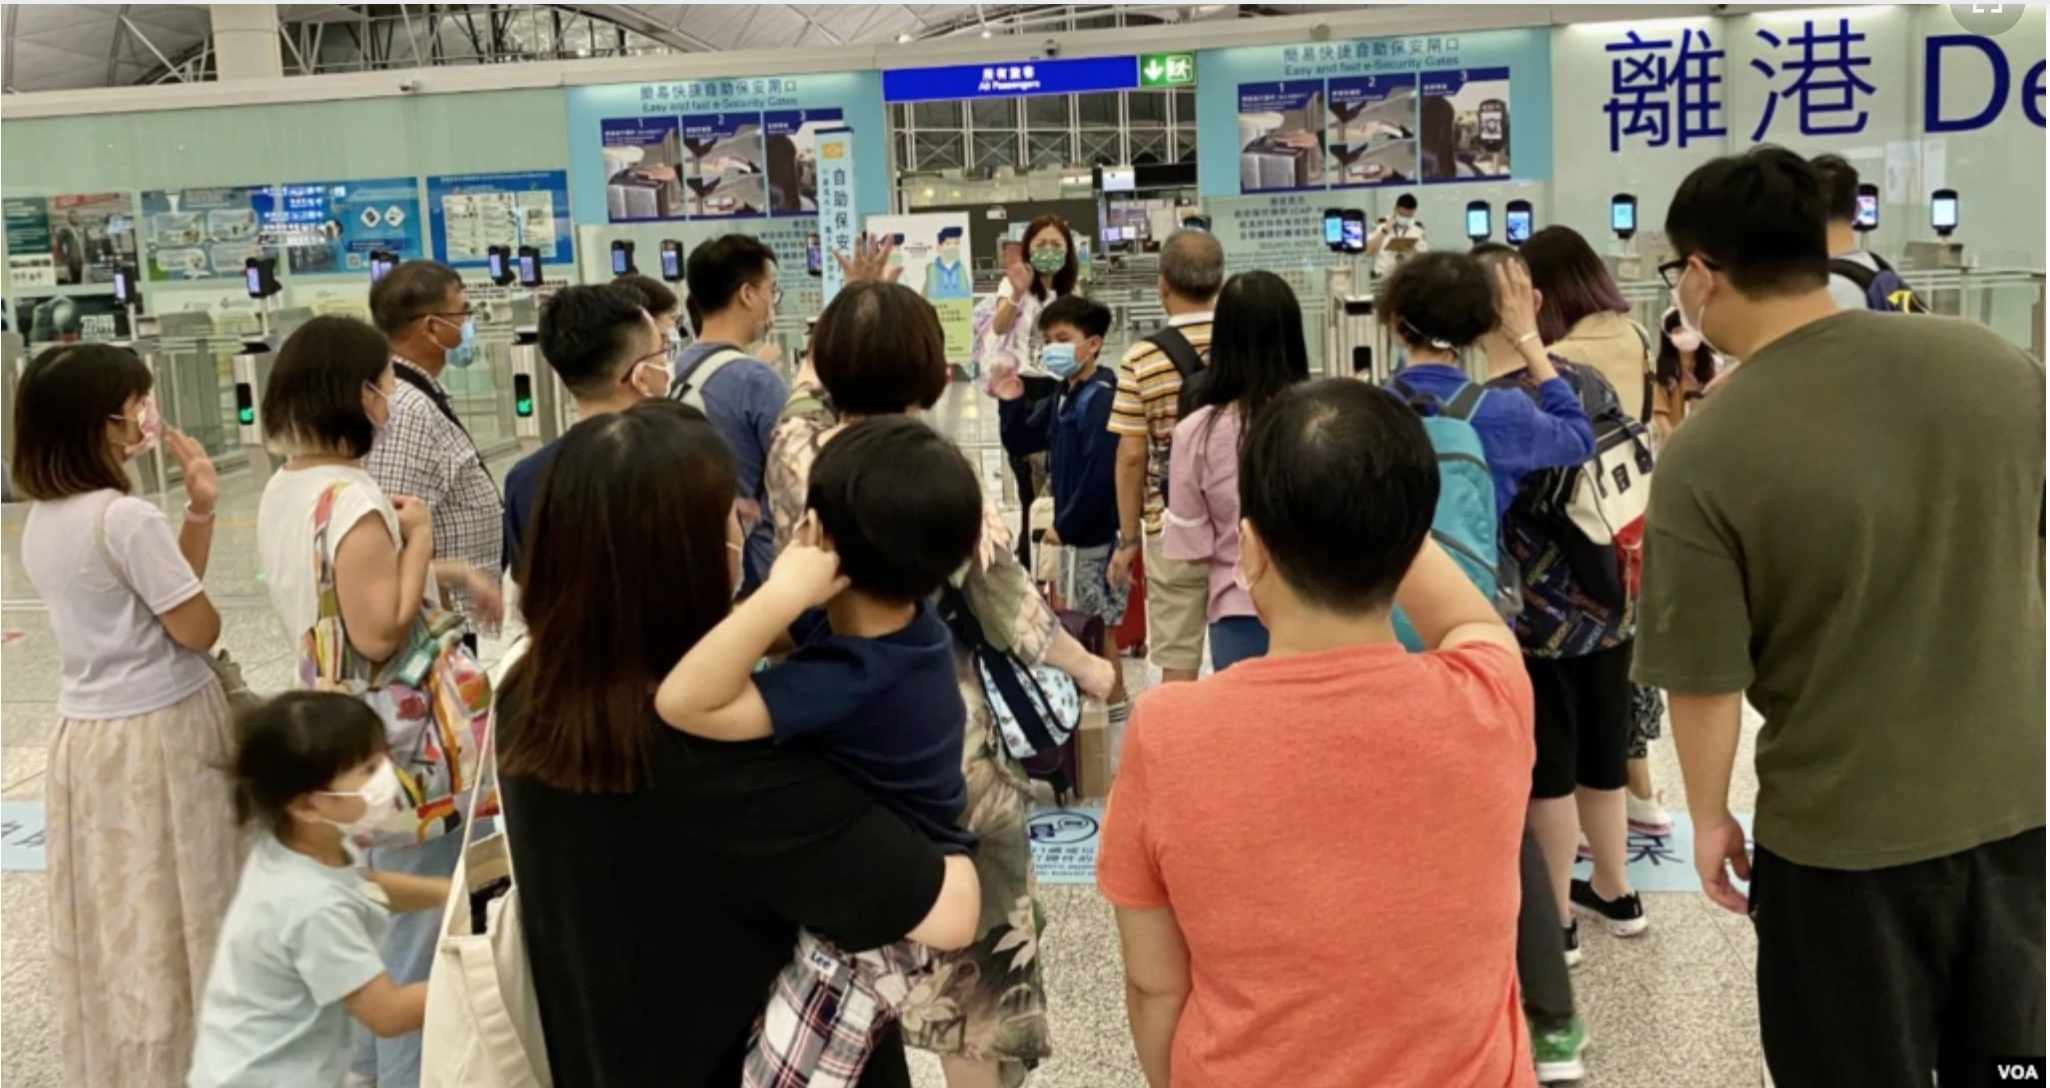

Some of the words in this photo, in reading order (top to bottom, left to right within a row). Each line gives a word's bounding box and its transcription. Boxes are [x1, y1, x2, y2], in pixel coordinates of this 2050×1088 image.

[1284, 64, 1313, 76] Easy
[1316, 61, 1337, 73] and
[1340, 60, 1361, 71] fast
[1363, 56, 1422, 71] e-Security
[1425, 55, 1460, 67] Gates
[1368, 76, 1376, 88] 2
[1459, 70, 1469, 82] 3
[1278, 82, 1285, 93] 1
[1602, 17, 1878, 152] 離港
[642, 102, 667, 114] Easy
[670, 100, 689, 111] and
[692, 99, 711, 110] fast
[714, 96, 764, 110] e-Security
[768, 95, 798, 106] Gates
[717, 115, 726, 125] 2
[799, 111, 807, 121] 3
[637, 118, 644, 128] 1
[811, 951, 831, 969] Lee
